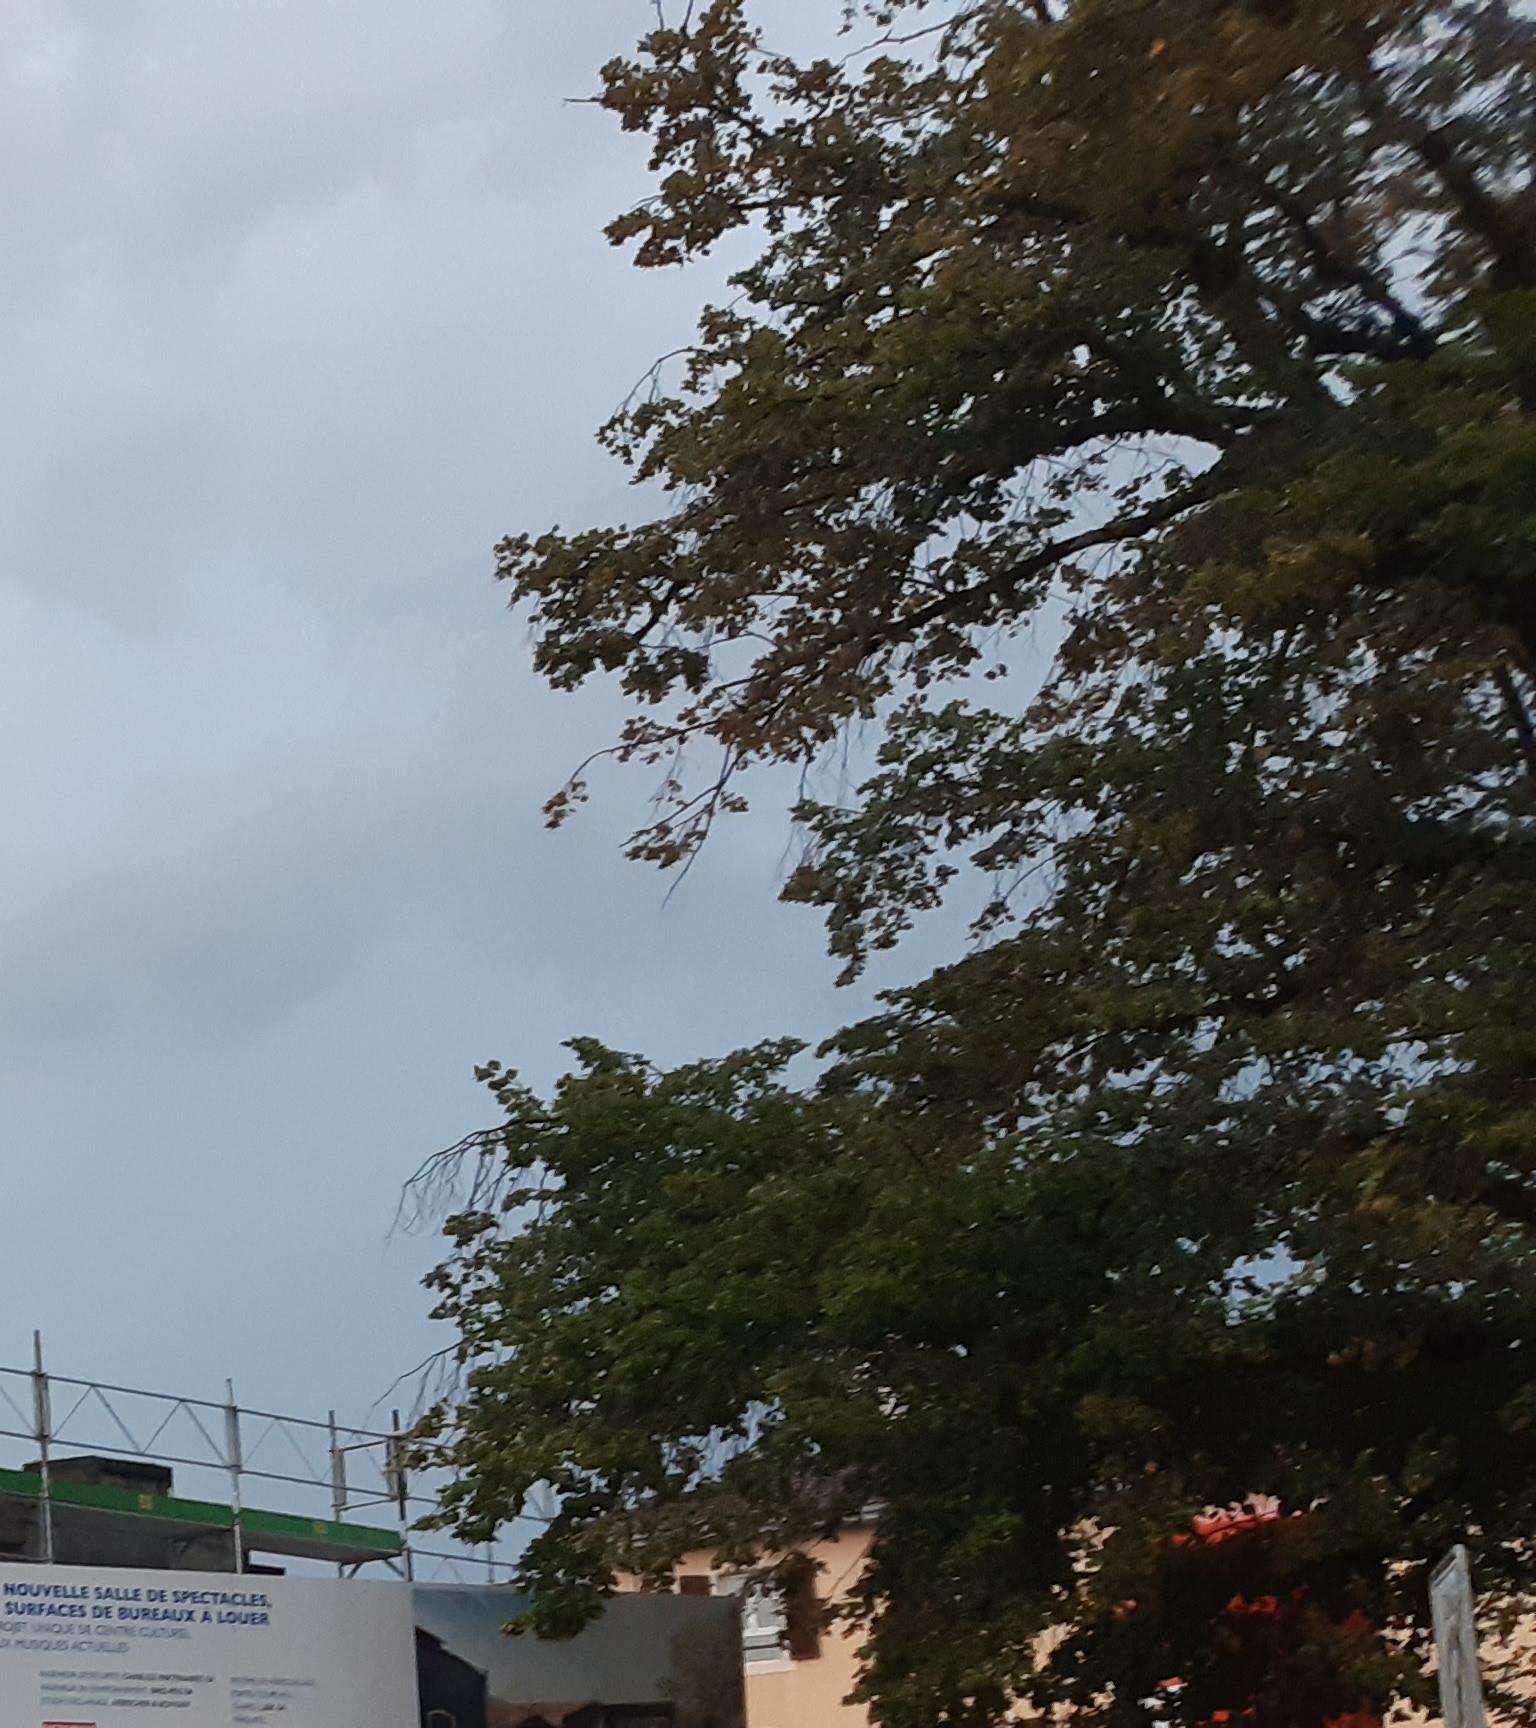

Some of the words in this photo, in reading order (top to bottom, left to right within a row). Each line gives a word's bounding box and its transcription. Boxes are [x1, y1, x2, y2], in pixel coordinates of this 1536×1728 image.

[3, 1582, 89, 1599] NOUVELLE
[94, 1586, 142, 1602] SALLE
[147, 1589, 168, 1603] DE
[4, 1602, 87, 1618] SURFACES
[92, 1605, 113, 1619] DE
[117, 1607, 196, 1623] BUREAUX
[217, 1611, 271, 1626] LOUER
